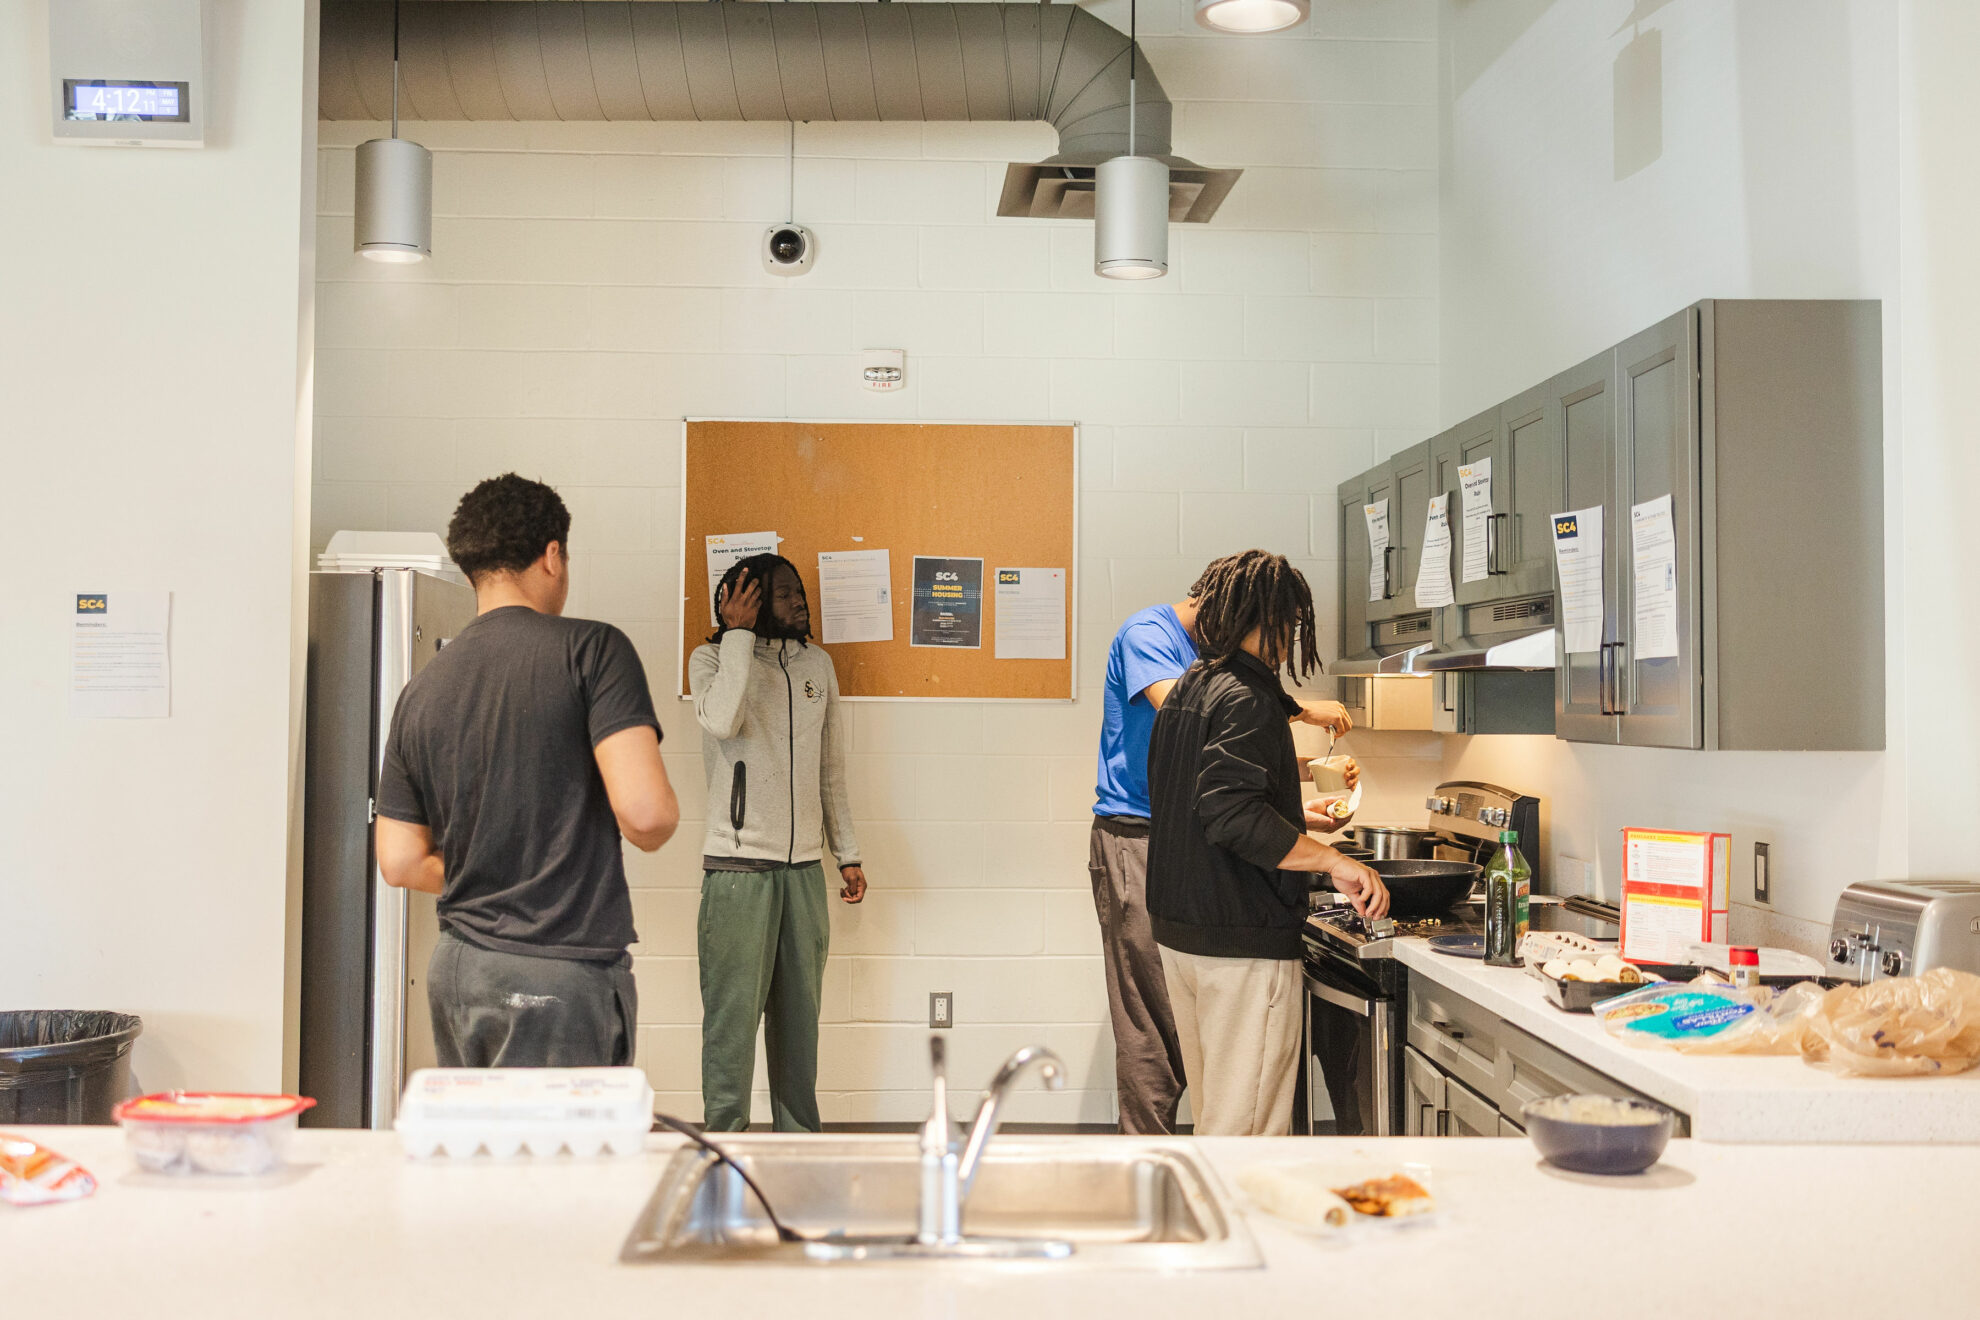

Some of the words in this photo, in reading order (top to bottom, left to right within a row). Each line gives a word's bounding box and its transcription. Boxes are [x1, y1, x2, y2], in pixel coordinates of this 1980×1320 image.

[91, 88, 141, 112] 4:12
[143, 100, 156, 113] 11
[1556, 521, 1577, 534] SC4
[707, 537, 726, 545] SC4
[935, 571, 959, 581] SC4
[1000, 573, 1019, 582] SC4
[932, 584, 963, 592] SUMMER
[931, 591, 964, 599] HOUSING
[78, 598, 105, 610] SC4
